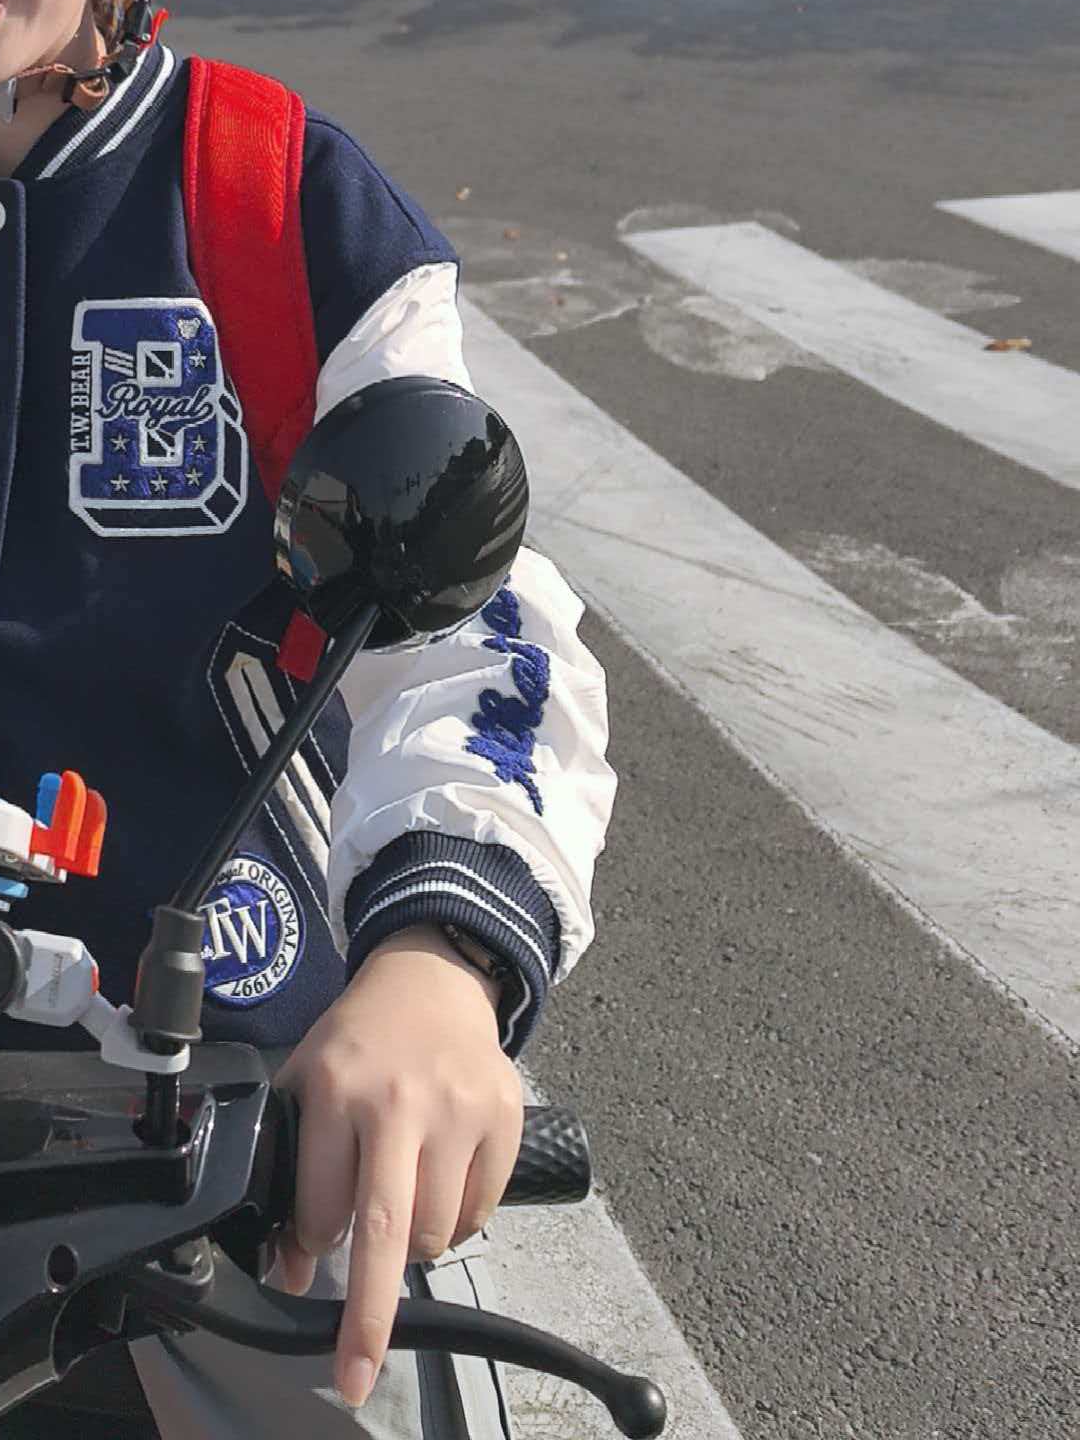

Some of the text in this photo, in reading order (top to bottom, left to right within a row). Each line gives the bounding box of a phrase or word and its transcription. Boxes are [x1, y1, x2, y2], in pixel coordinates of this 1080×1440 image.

[70, 352, 91, 451] T.W. BEAR
[94, 382, 220, 429] Royal
[248, 863, 297, 951] ORIGINAL
[230, 971, 272, 997] 1997
